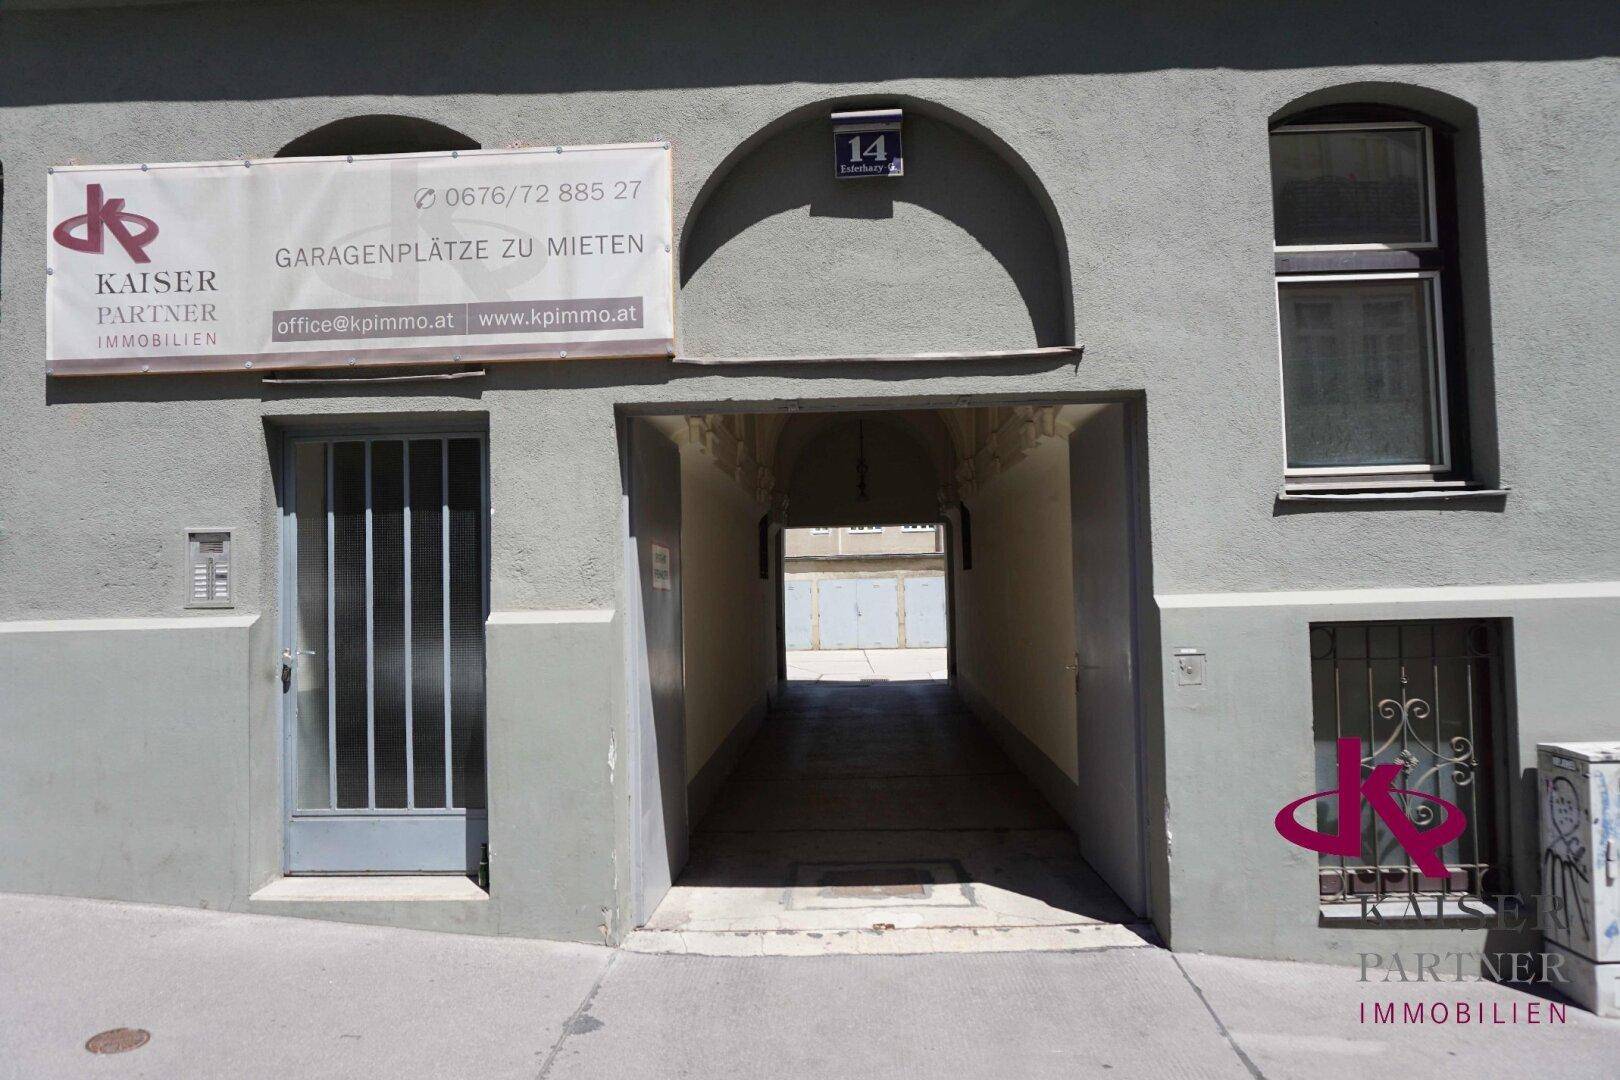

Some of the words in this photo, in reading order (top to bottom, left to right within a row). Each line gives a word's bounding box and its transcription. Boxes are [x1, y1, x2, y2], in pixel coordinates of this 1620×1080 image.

[848, 134, 888, 162] 14
[445, 184, 550, 208] 0676/72
[558, 182, 605, 203] 885
[613, 180, 643, 200] 27
[275, 237, 489, 268] GARAGENPLÄTZE
[501, 237, 534, 258] ZU
[547, 234, 644, 256] MIETEN
[95, 269, 219, 295] KAISER
[97, 303, 217, 325] PARTNER
[277, 312, 455, 335] office@kpimmo.at
[478, 305, 637, 328] www.kpimmo.at
[98, 331, 217, 349] IMMOBILIEN
